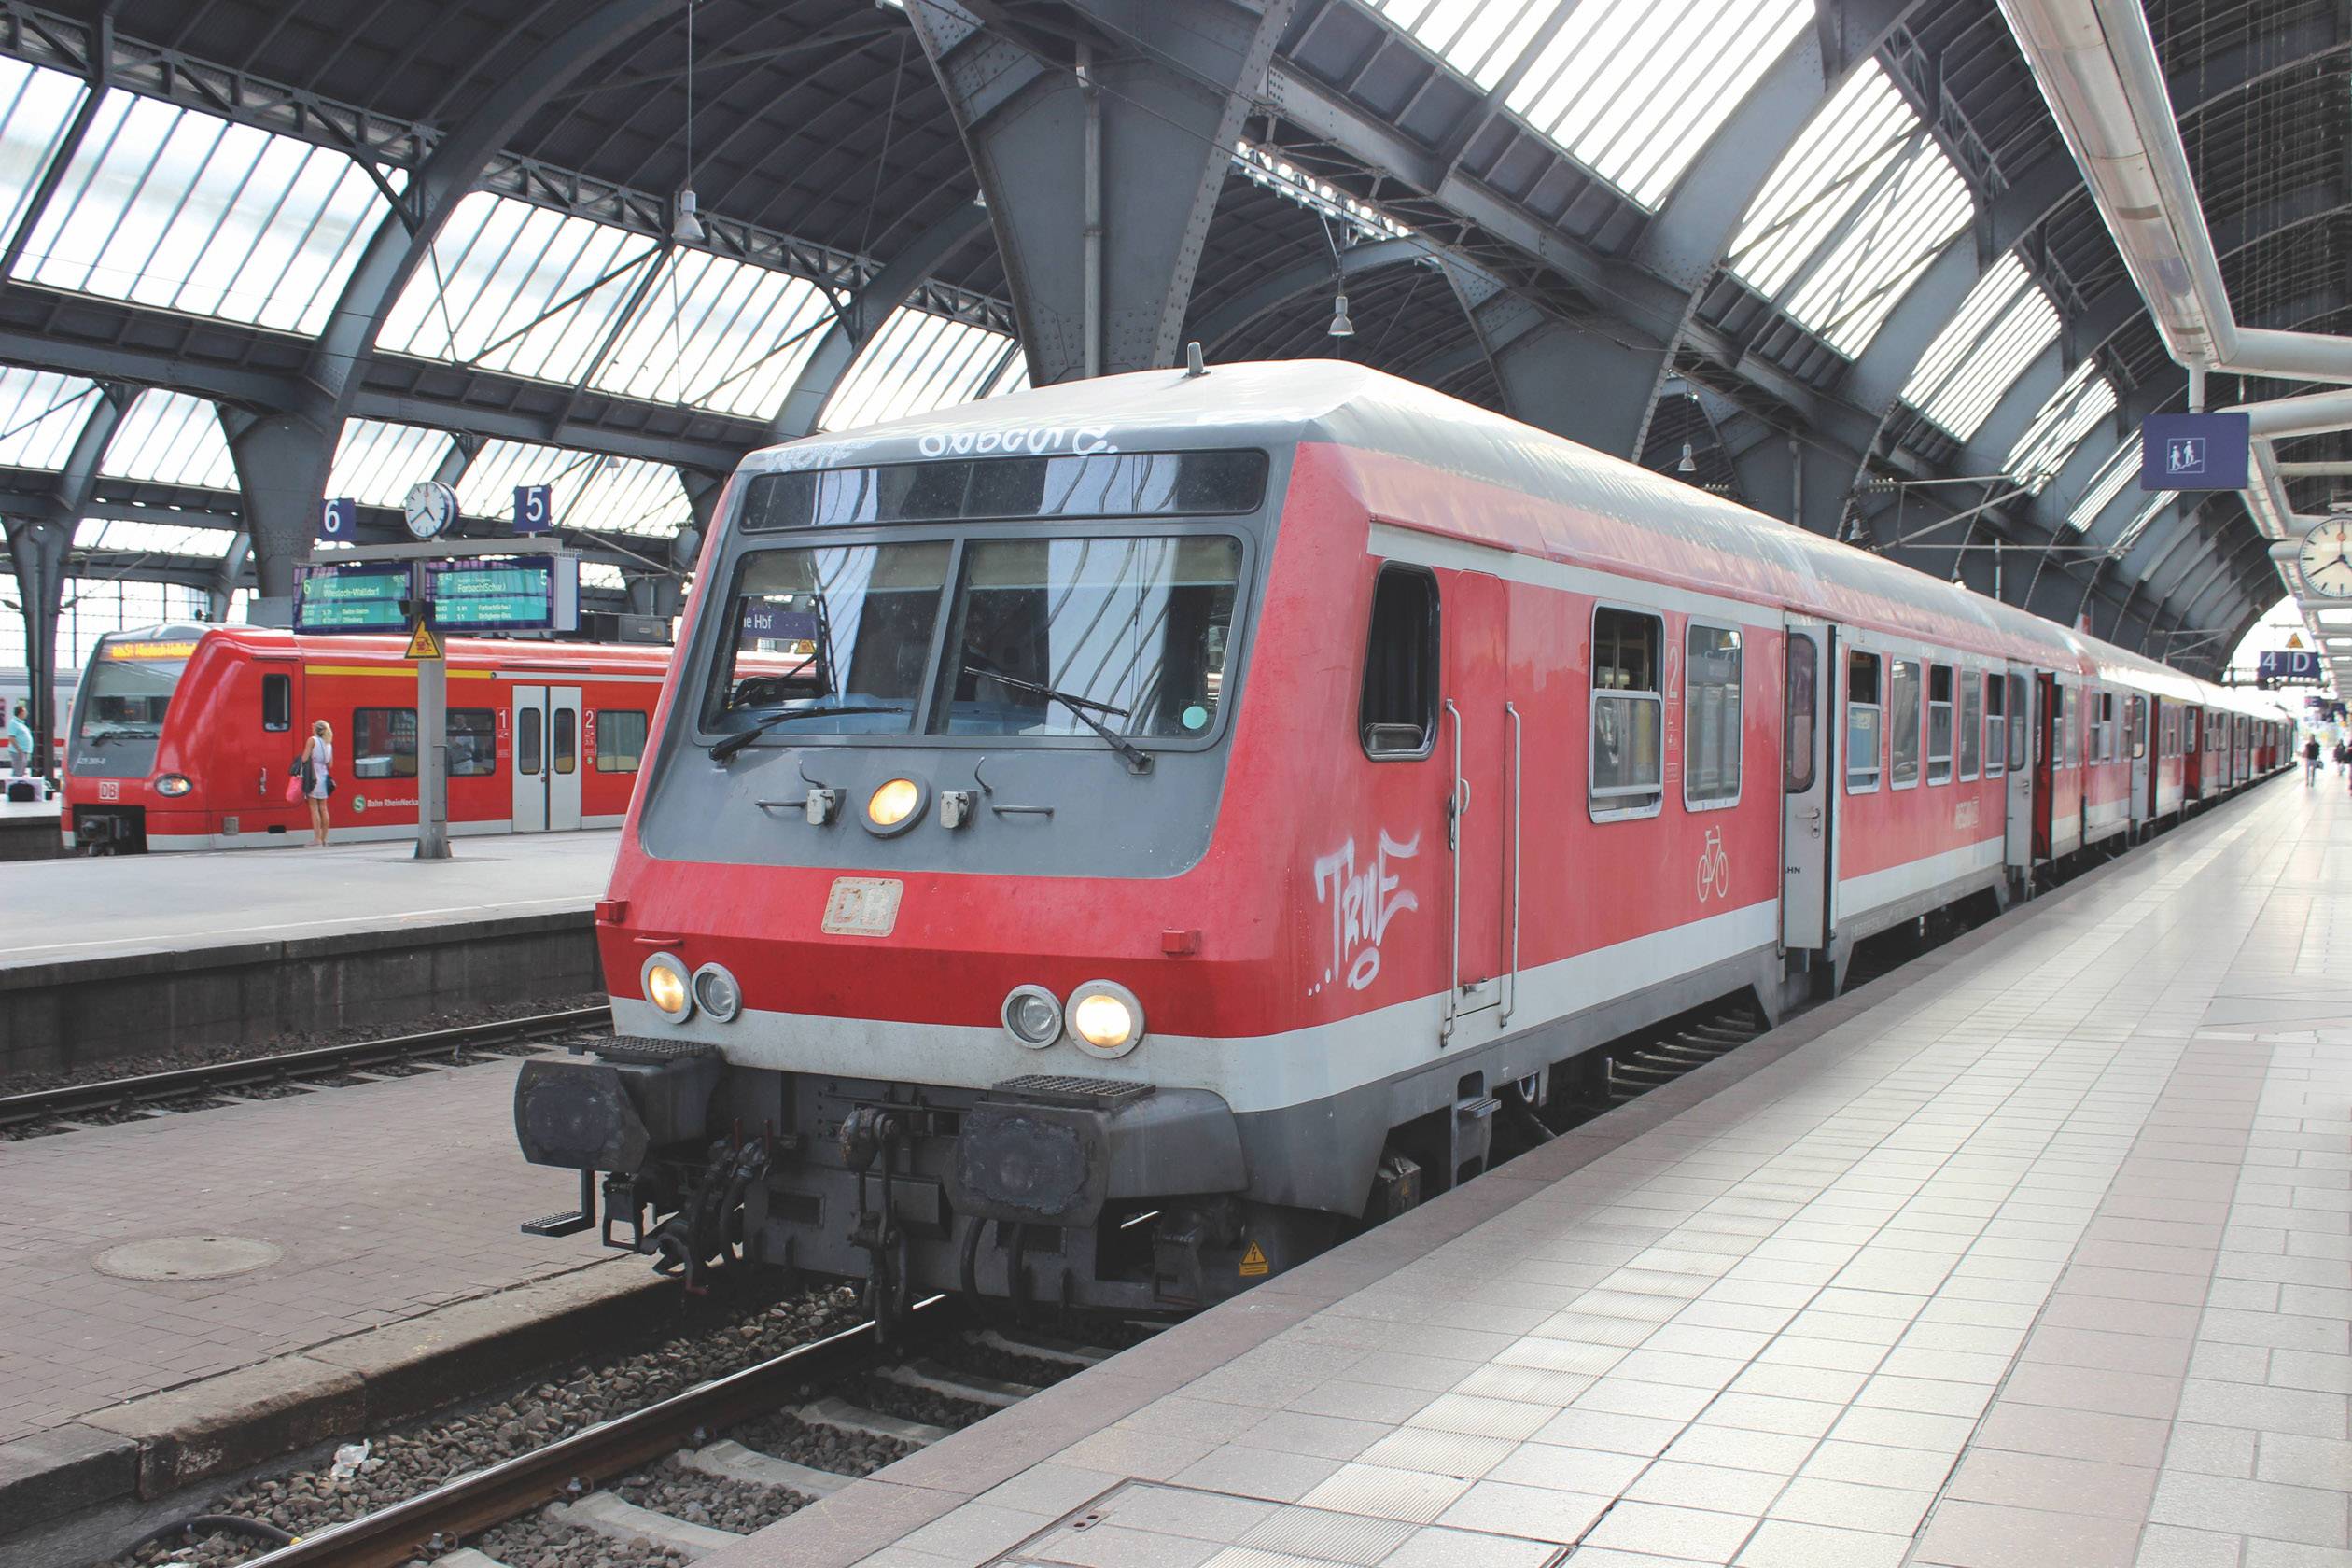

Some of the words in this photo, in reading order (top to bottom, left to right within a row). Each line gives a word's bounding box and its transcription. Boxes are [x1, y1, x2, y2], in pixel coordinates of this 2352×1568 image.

[526, 487, 542, 521] 5
[325, 500, 340, 532] 6
[303, 580, 311, 595] 6
[755, 614, 772, 629] Hbf
[2262, 652, 2277, 671] 4
[2292, 653, 2310, 672] D
[1669, 646, 1678, 698] 2
[499, 710, 506, 728] 1
[585, 710, 594, 728] 2
[101, 784, 118, 798] DB
[368, 799, 383, 807] Bahn
